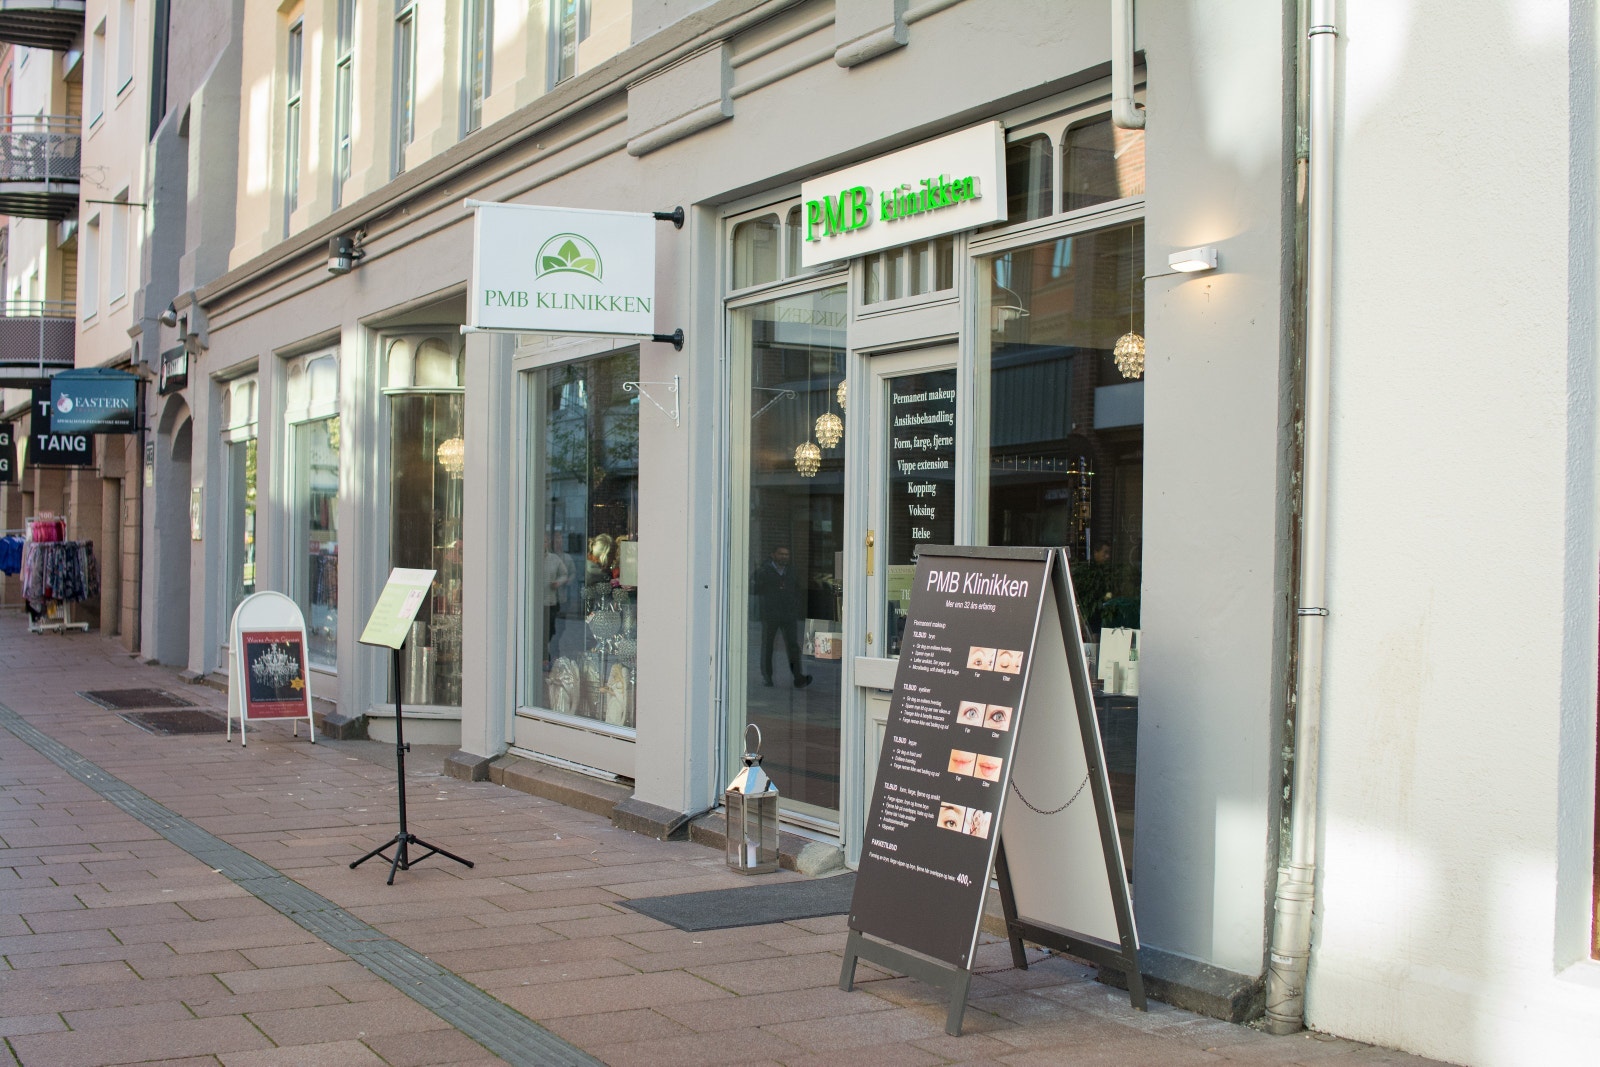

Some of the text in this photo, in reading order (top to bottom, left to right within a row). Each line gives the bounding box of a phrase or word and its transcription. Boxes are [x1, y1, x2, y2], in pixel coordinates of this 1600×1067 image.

[805, 174, 982, 242] PMB klinikken
[485, 290, 651, 313] PMB KLINIKKEN
[75, 398, 128, 408] EASTERN
[893, 388, 956, 404] Permanent makeup
[894, 411, 954, 426] Ansiktsbehandling
[38, 435, 86, 451] TANG
[894, 434, 953, 451] Form, farge, fjerne
[897, 458, 948, 475] Vippe extension
[908, 482, 936, 497] Kopping
[908, 504, 935, 520] Voksing
[912, 528, 930, 538] Helse
[926, 570, 1028, 598] PMB Klinikken
[946, 600, 954, 608] Mer
[964, 601, 970, 609] 32
[970, 602, 978, 610] års
[978, 602, 996, 612] erfaring
[956, 872, 972, 886] 400,-
